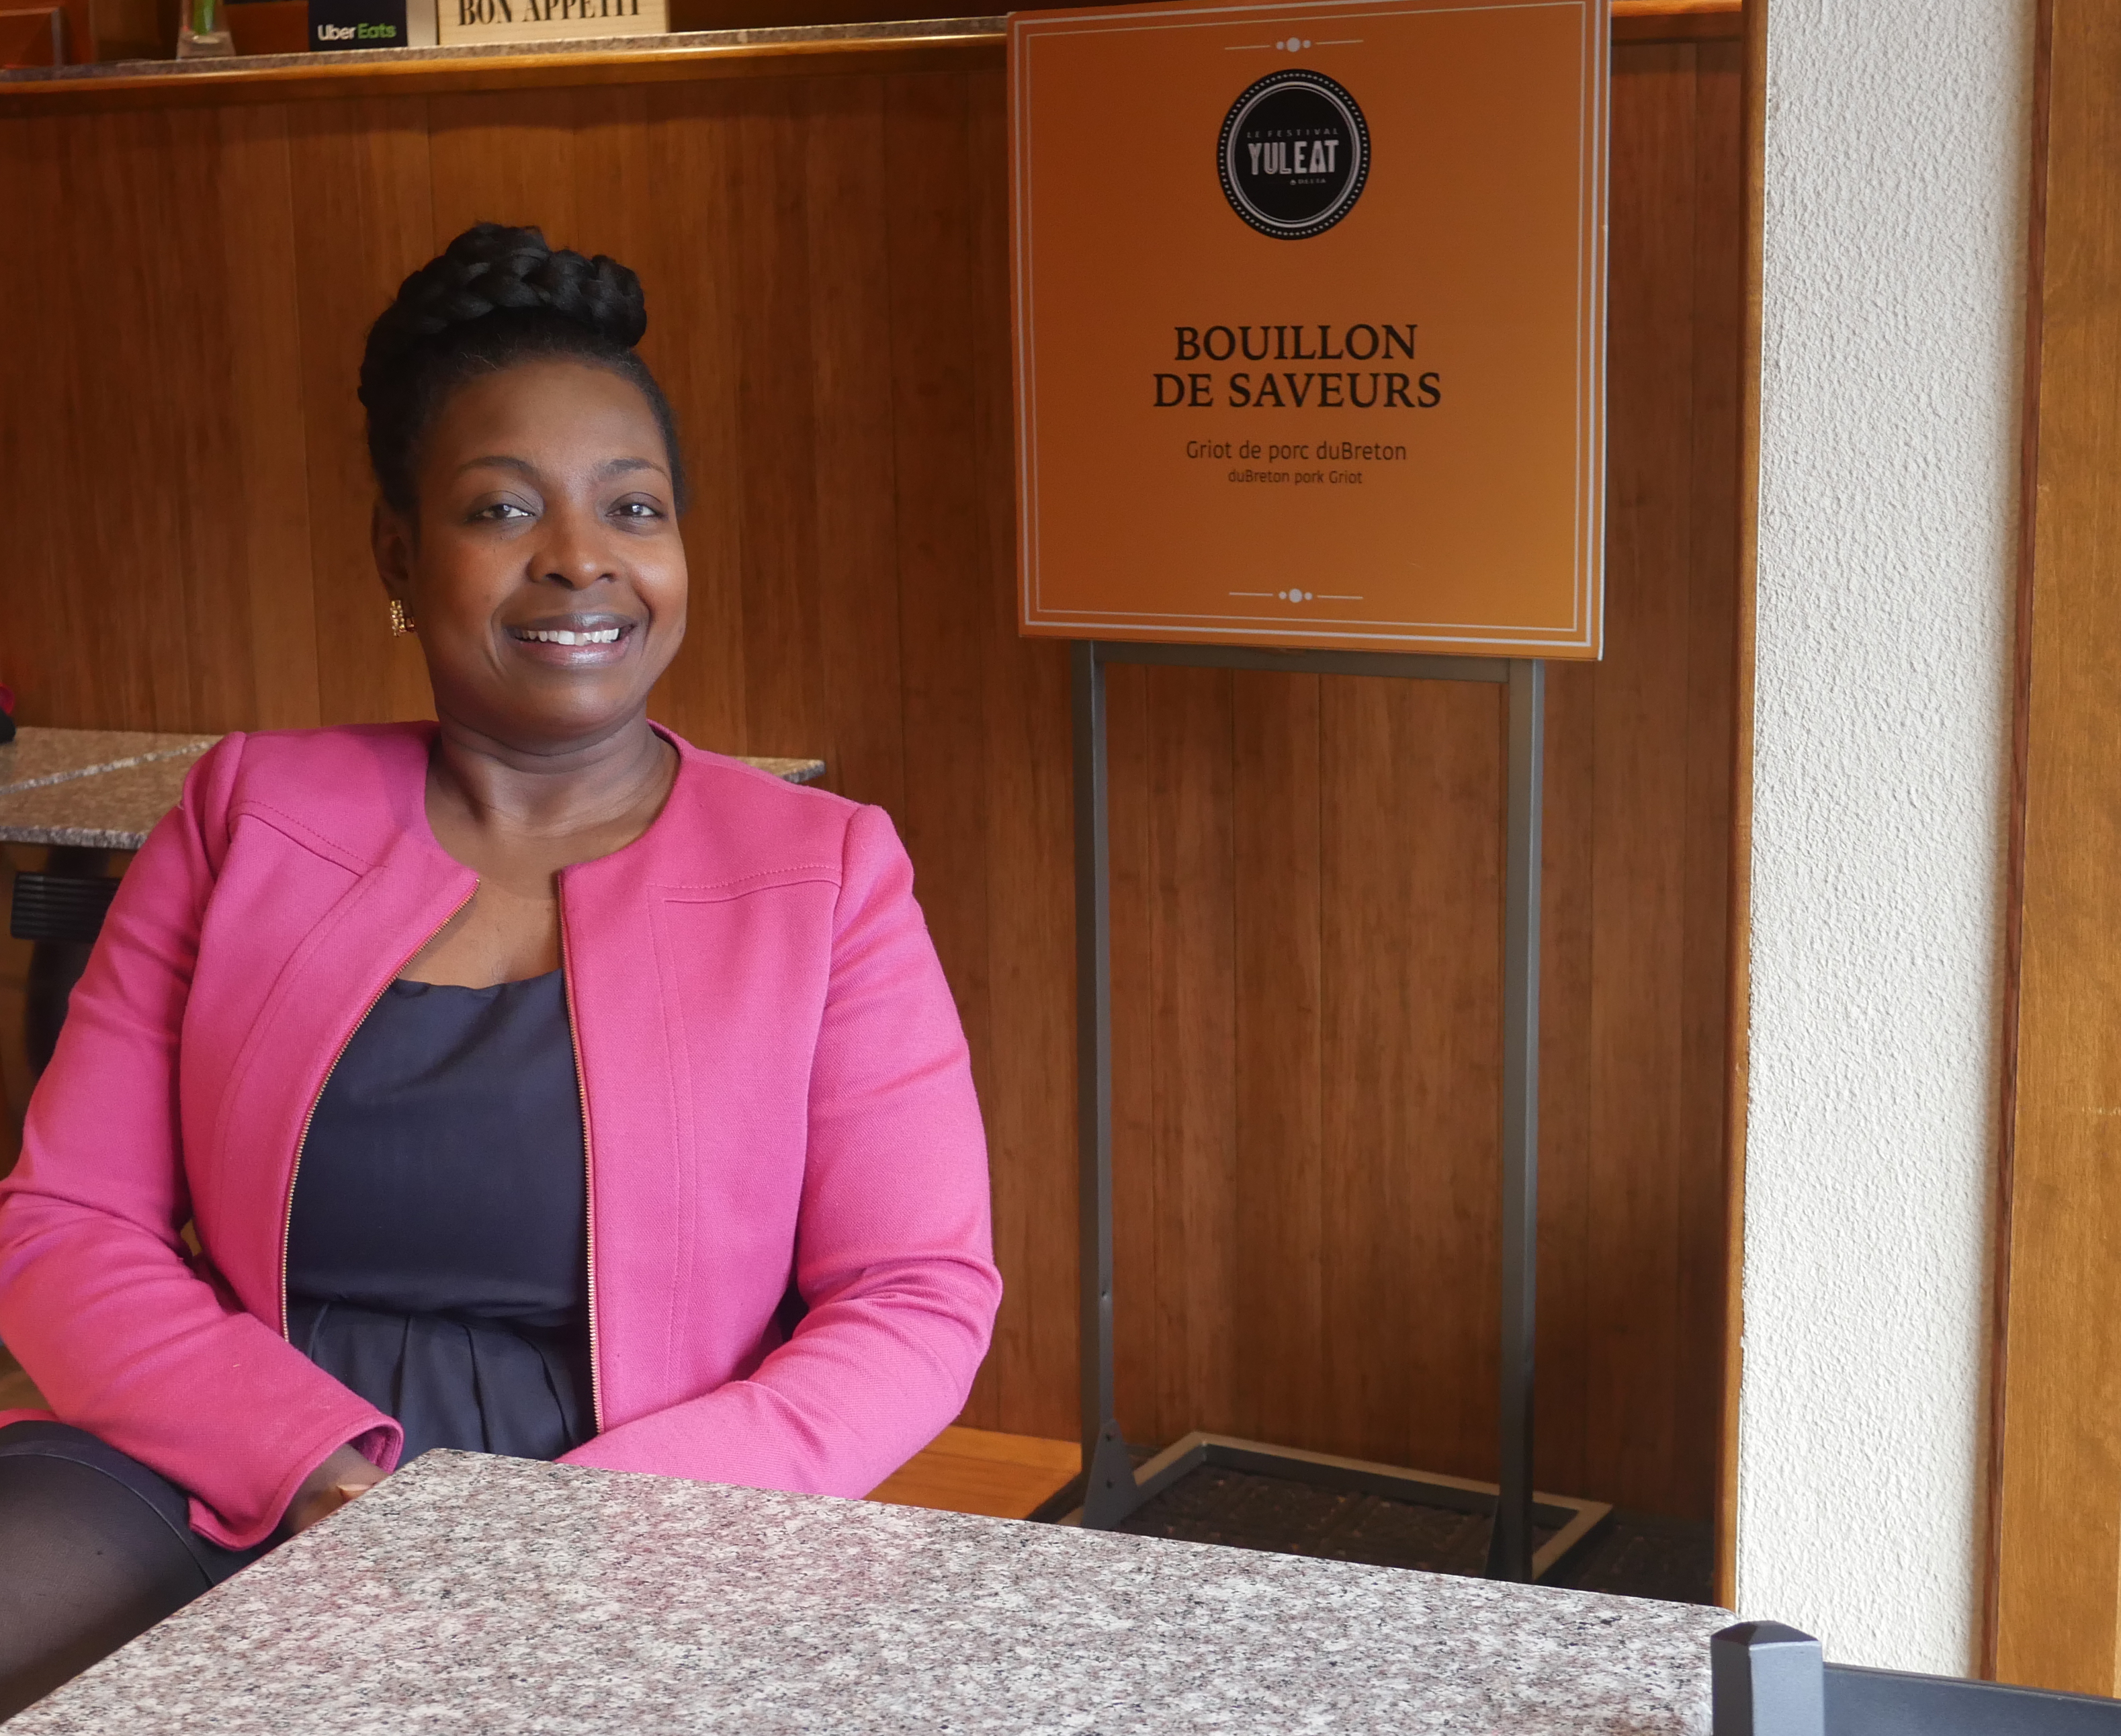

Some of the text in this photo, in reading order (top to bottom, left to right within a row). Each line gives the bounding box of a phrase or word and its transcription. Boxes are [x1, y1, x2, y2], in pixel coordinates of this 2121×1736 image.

[458, 0, 513, 26] BON
[318, 23, 396, 41] Uber Eats
[1267, 128, 1339, 138] FESTIVAL
[1248, 139, 1339, 175] YULEAT
[1174, 323, 1418, 361] BOUILLON
[1153, 371, 1441, 408] DE SAVEURS
[1186, 440, 1407, 464] Griot de porc duBreton
[1227, 469, 1362, 484] duBreton pork Griot
